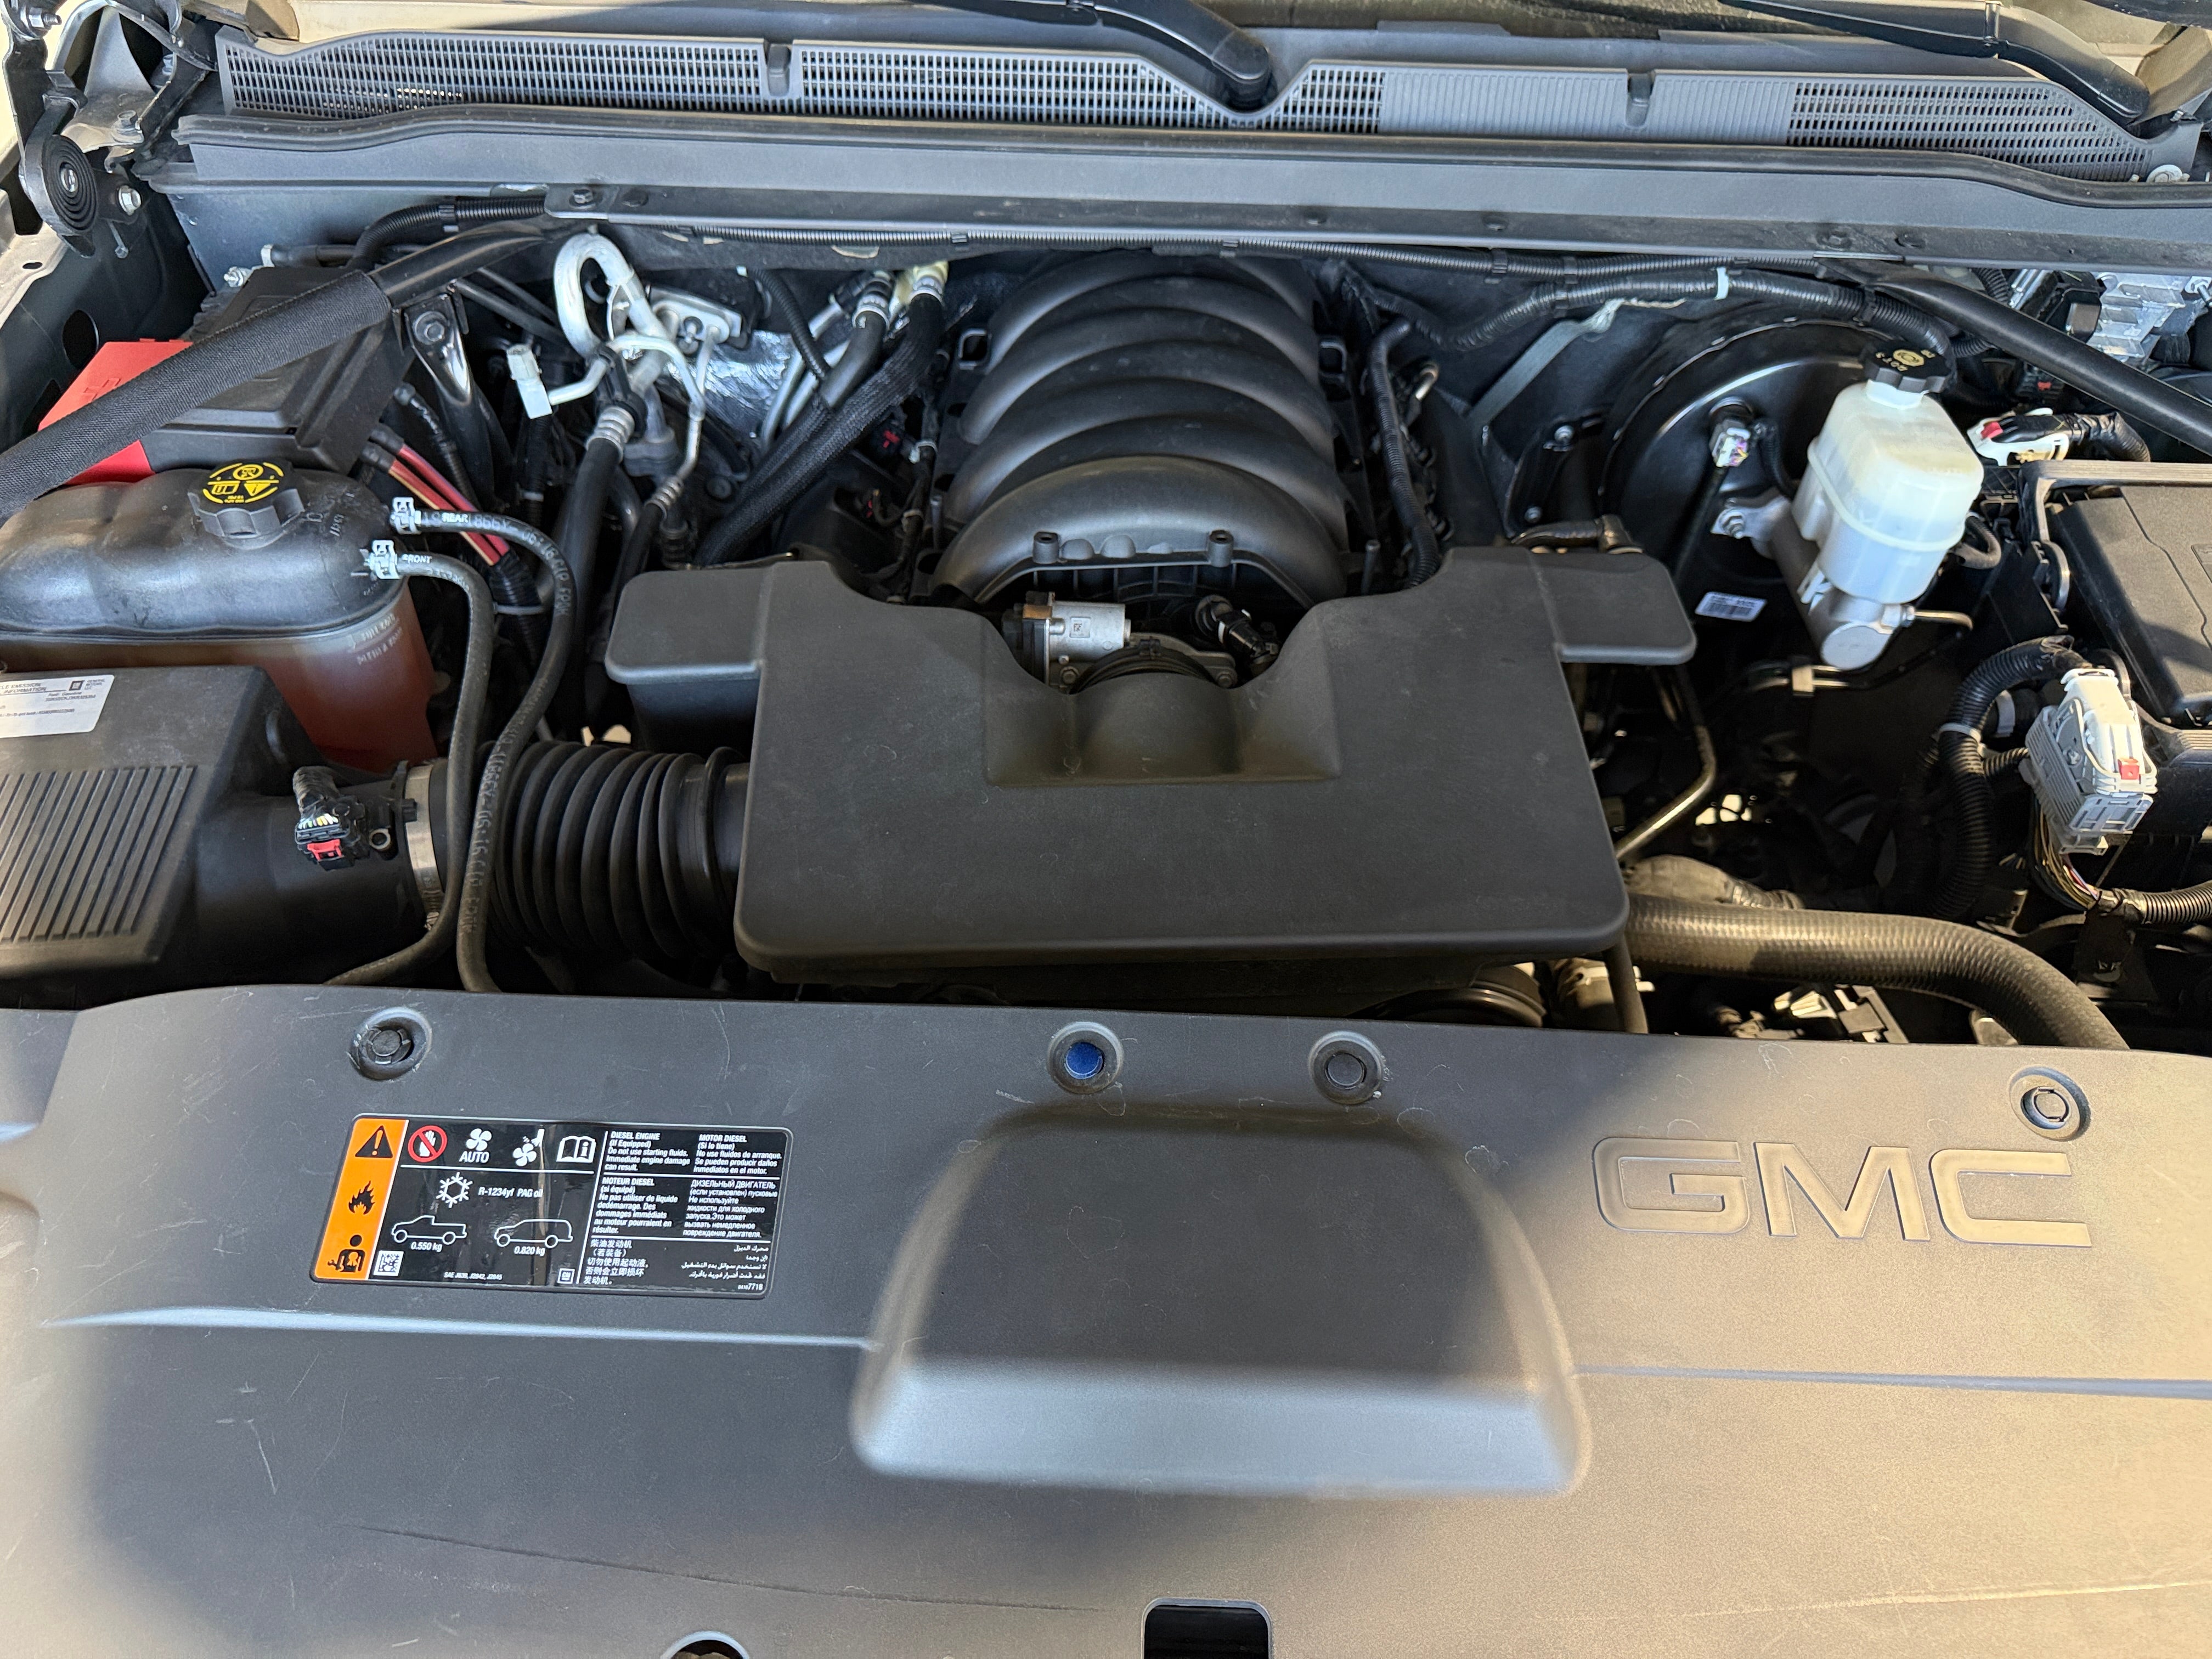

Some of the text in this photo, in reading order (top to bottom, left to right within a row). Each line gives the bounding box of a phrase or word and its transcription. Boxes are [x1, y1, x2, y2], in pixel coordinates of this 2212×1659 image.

[441, 512, 469, 523] REAR
[611, 1131, 661, 1140] DIESEL ENGINE
[724, 1135, 748, 1143] DIESEL
[609, 1139, 652, 1148] (If Equipped)
[697, 1142, 707, 1150] (Si
[716, 1143, 735, 1151] tiene)
[459, 1151, 490, 1163] AUTO
[643, 1148, 668, 1157] starting
[669, 1149, 689, 1157] fluids.
[696, 1149, 706, 1158] No
[719, 1150, 742, 1158] fluidos
[752, 1152, 782, 1160] arranque.
[606, 1155, 691, 1166] Immediate engine damage
[695, 1157, 778, 1167] Se pueden producir daños
[693, 1165, 729, 1173] inmediatos
[602, 1177, 655, 1186] MOTEUR DIESEL
[690, 1180, 776, 1189] ДИЗЕЛЬНЫЙ ДВИГАТЕЛЬ
[478, 1187, 544, 1199] R-1234yf PAG oil
[600, 1185, 636, 1194] (si équipé)
[690, 1188, 778, 1198] (если установлен) пусковые
[1592, 1136, 2092, 1247] GMC
[599, 1193, 609, 1201] Ne
[622, 1193, 646, 1202] utiliser
[656, 1194, 679, 1204] liquide
[688, 1195, 739, 1206] Не используйте
[595, 1209, 668, 1220] dommages immédiats
[731, 1206, 765, 1214] холодного
[628, 1219, 663, 1228] pourraient
[592, 1226, 619, 1234] résulter.
[682, 1229, 726, 1238] повреждение
[410, 1242, 443, 1252] 0.550 kg
[590, 1239, 633, 1249] 柴油发动机
[751, 1245, 769, 1253] محرك
[514, 1246, 546, 1257] 0.820 kg
[585, 1266, 645, 1277] 否则会立即损坏
